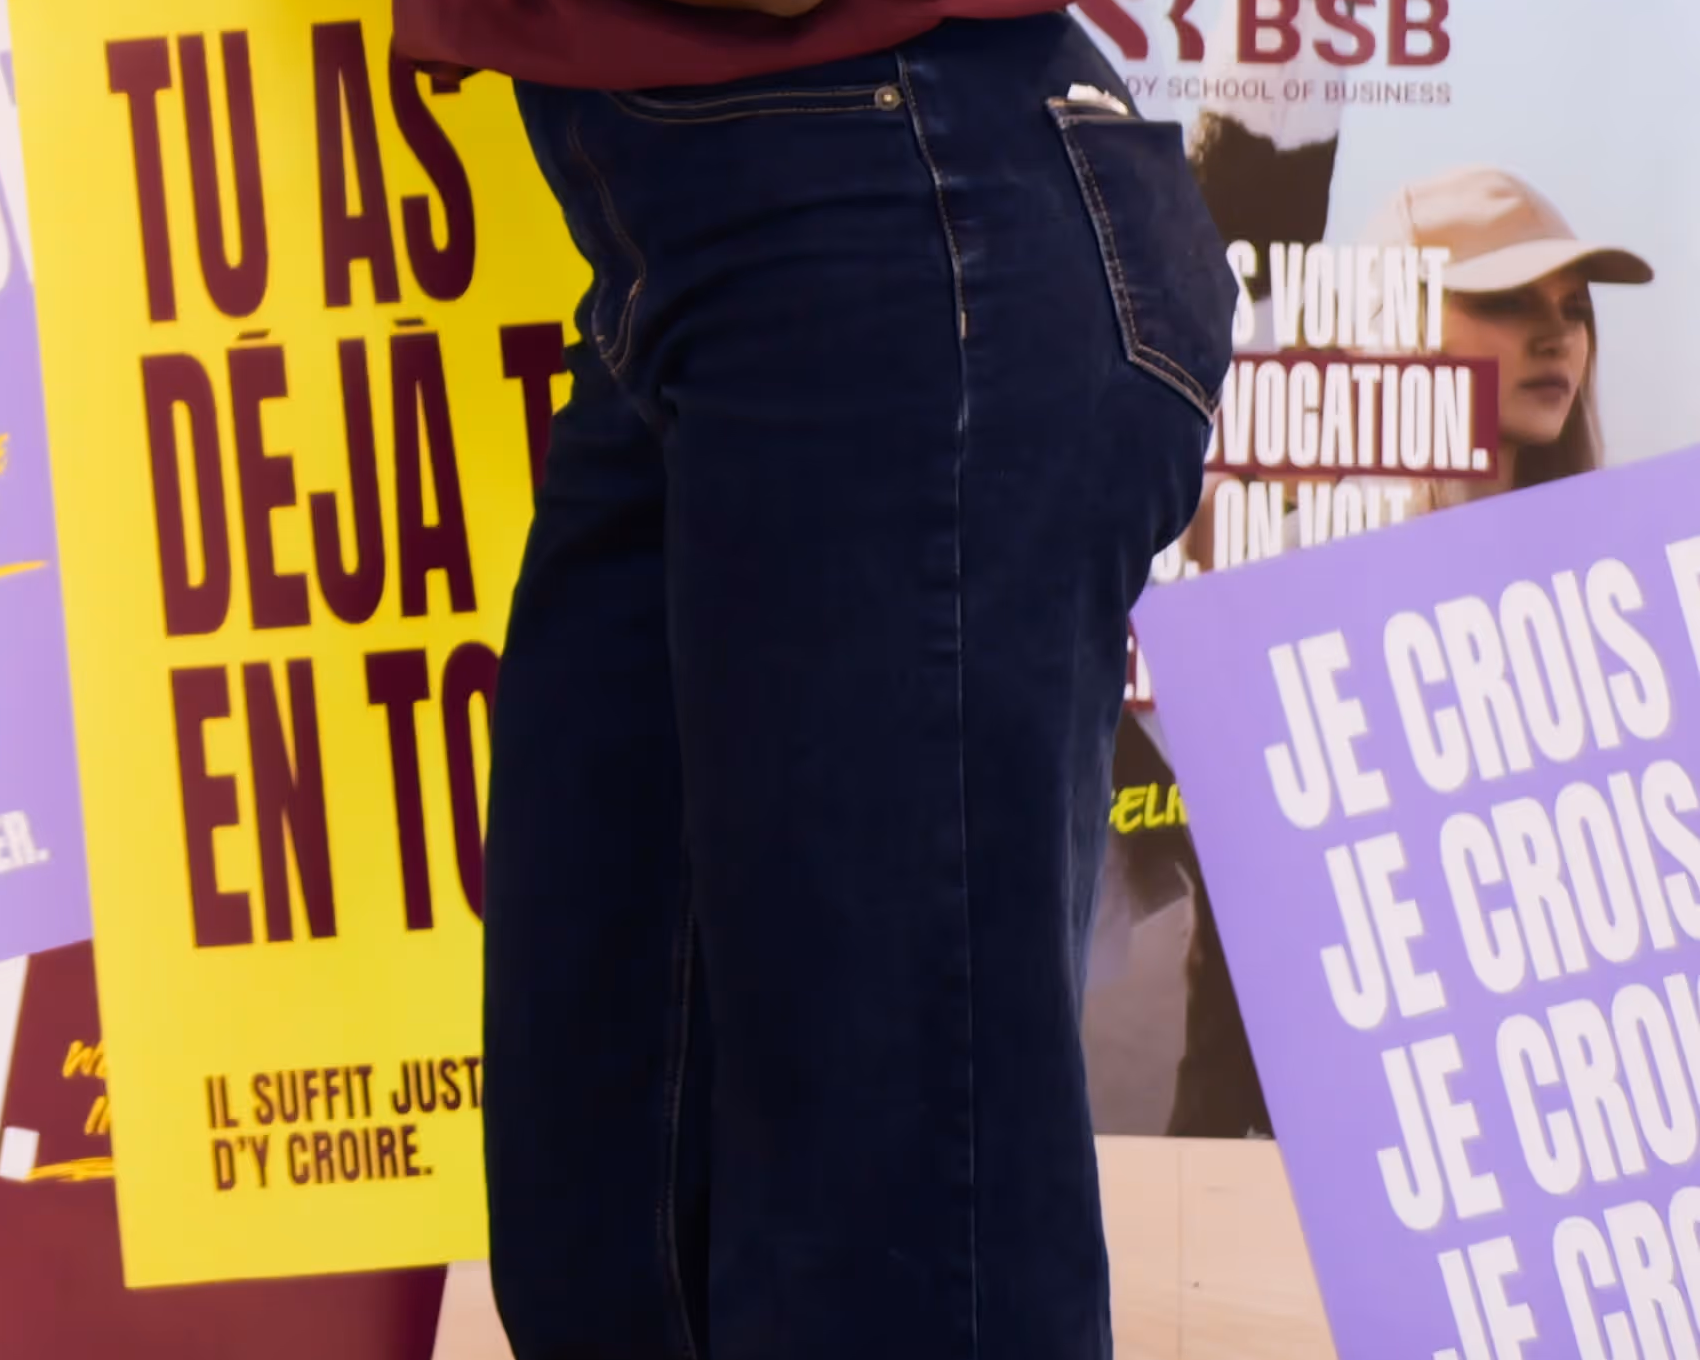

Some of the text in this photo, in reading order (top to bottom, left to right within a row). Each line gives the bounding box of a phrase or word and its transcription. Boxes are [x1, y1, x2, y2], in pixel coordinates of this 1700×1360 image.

[104, 19, 476, 323] TU AS
[1167, 77, 1271, 101] SCHOOL
[1284, 79, 1313, 102] OF
[1324, 80, 1451, 105] BUSINESS
[1269, 241, 1450, 351] VOIENT
[1213, 480, 1284, 572] ON
[1264, 630, 1390, 829] JE
[1384, 558, 1672, 793] CROIS
[167, 641, 501, 949] EN TO
[1321, 760, 1700, 1030] JE CROIS
[205, 1055, 485, 1129] IL SUFFIT JUST
[287, 1124, 435, 1186] CROIRE.
[1377, 972, 1700, 1231] JE CROI
